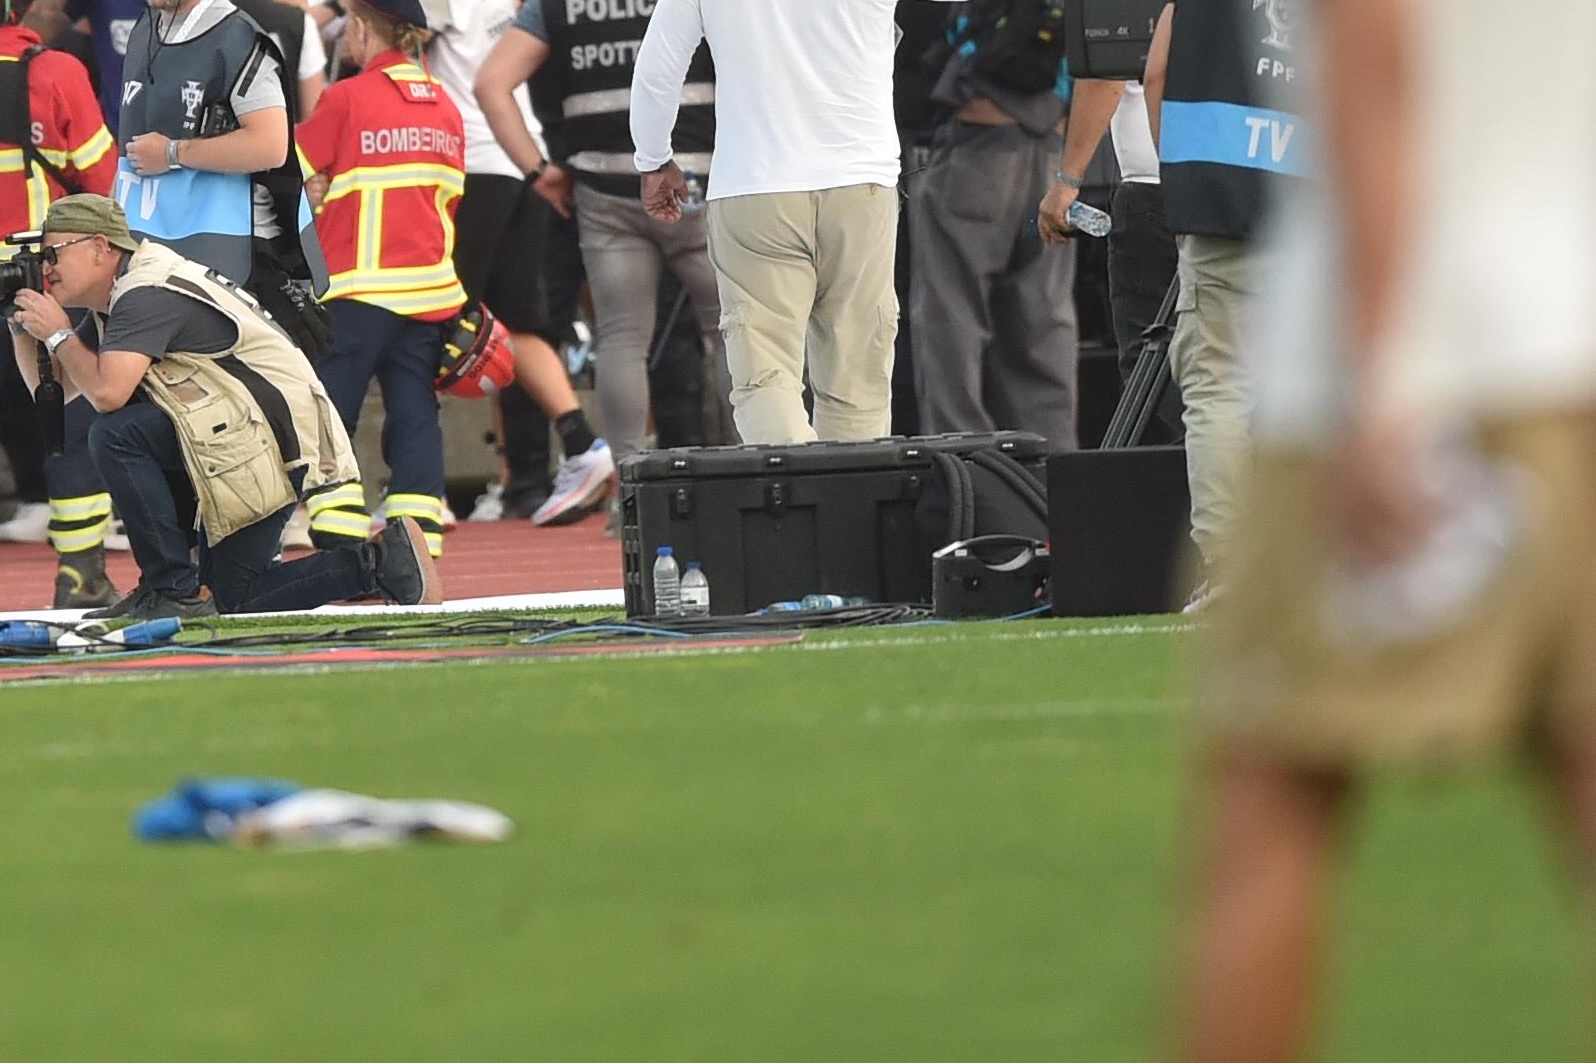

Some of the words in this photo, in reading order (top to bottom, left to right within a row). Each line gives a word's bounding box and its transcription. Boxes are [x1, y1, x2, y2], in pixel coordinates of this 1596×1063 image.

[570, 38, 643, 70] SPOTT
[1256, 56, 1297, 83] FPF
[1244, 116, 1296, 164] TV
[118, 171, 160, 221] TV
